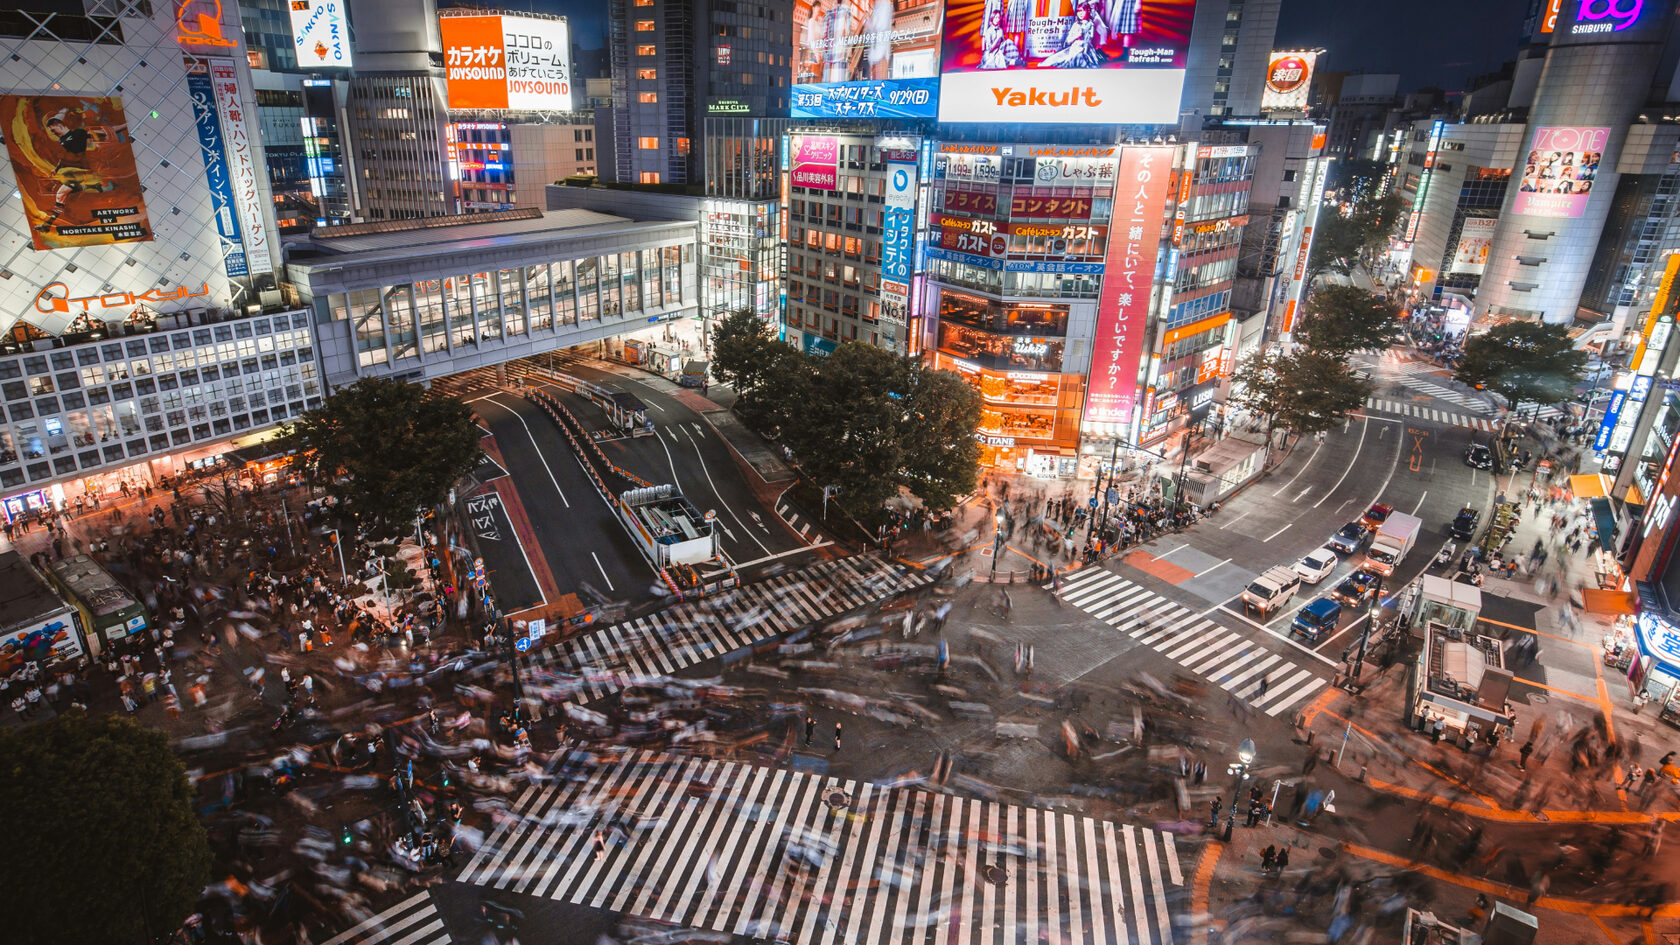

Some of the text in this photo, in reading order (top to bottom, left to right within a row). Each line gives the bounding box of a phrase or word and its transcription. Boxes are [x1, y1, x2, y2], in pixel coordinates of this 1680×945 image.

[296, 5, 324, 46] SANKYO
[327, 3, 343, 60] SANKYO
[1572, 23, 1613, 34] SHIBUYA
[177, 36, 238, 47] TOKYU
[506, 33, 552, 50] ココロの
[448, 46, 502, 66] カラオケ
[508, 50, 567, 68] ボリューム、
[1128, 55, 1160, 63] Refresh
[1130, 48, 1174, 56] Tough-Man
[450, 67, 505, 80] JOYSOUND
[508, 67, 568, 80] あげていこう。
[1271, 68, 1303, 82] 楽園
[509, 80, 569, 95] JOYSOUND
[991, 87, 1103, 107] Yakult
[936, 161, 947, 170] 9F
[1063, 162, 1114, 179] しゃぶ葉
[946, 192, 995, 209] プライス
[1011, 198, 1090, 215] コンタクト
[97, 208, 135, 216] ARTWORK
[971, 219, 998, 235] ガスト
[1061, 226, 1099, 240] ガスト
[956, 234, 988, 252] ガスト
[1035, 263, 1103, 274] 英会話イーオン
[70, 284, 209, 312] TOKYU
[1099, 407, 1129, 417] tinder
